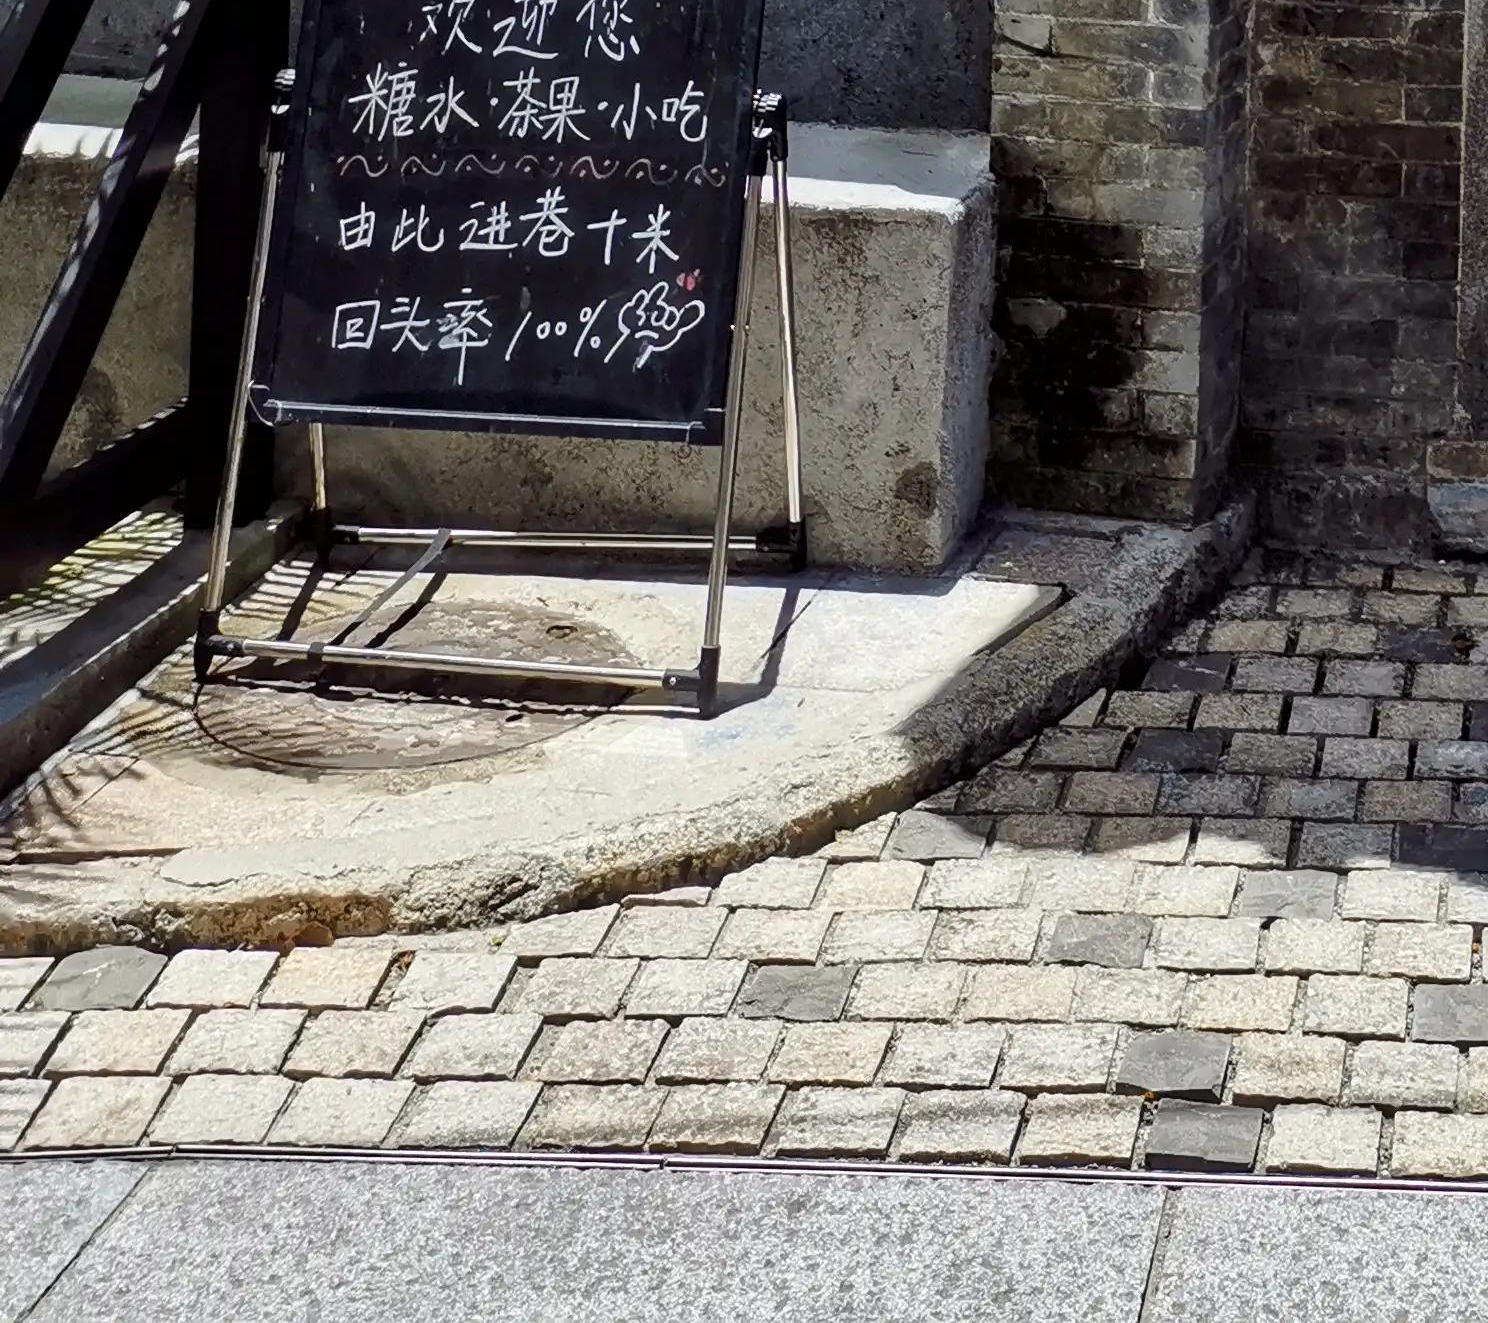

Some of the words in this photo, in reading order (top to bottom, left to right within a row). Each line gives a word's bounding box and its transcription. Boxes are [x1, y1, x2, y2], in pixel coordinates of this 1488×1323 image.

[338, 185, 680, 274] 由此进巷十米
